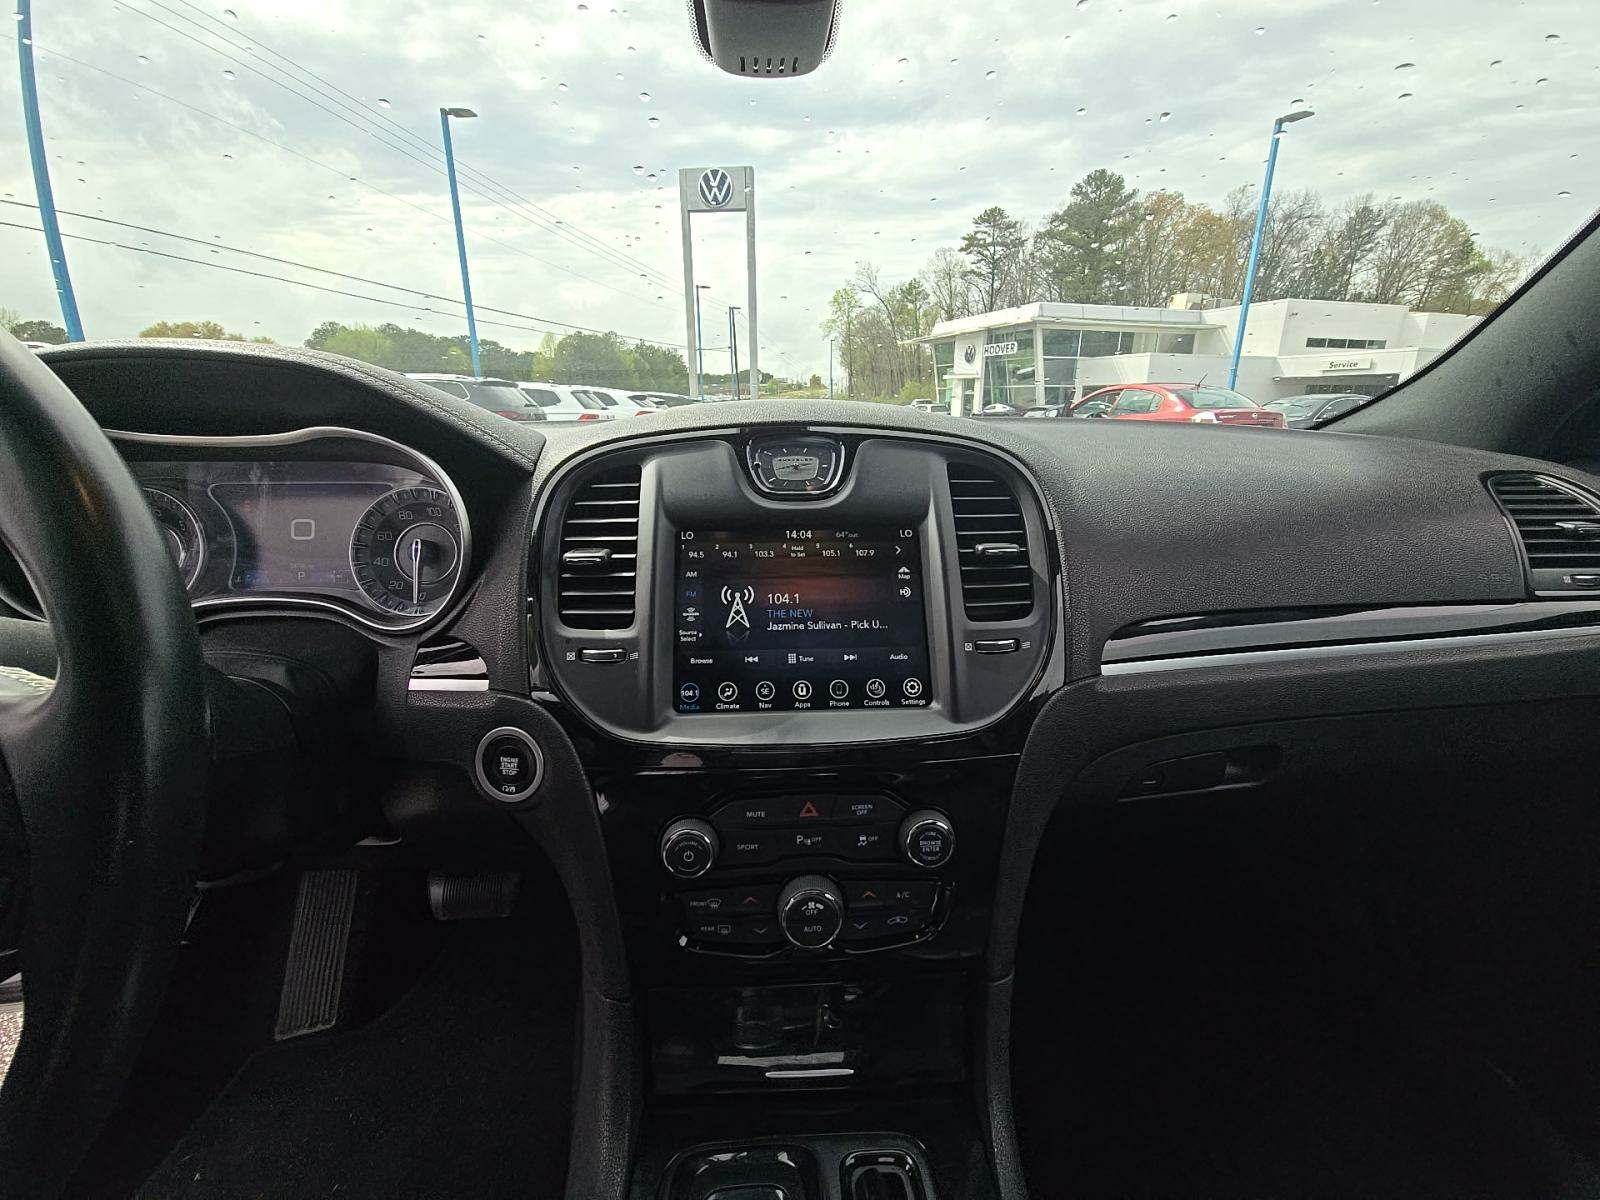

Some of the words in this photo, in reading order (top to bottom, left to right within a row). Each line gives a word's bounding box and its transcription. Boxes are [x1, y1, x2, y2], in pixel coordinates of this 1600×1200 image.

[984, 343, 1016, 355] HOOVER
[1328, 361, 1359, 369] Service
[399, 510, 413, 520] 80
[377, 531, 393, 541] 60
[681, 531, 694, 540] LO
[785, 530, 812, 539] 14:04
[900, 529, 913, 538] LO
[688, 551, 705, 559] 94.5
[754, 550, 775, 558] 103.3
[822, 549, 841, 557] 105.1
[855, 549, 875, 557] 107.9
[373, 557, 389, 567] 40
[389, 580, 404, 590] 20
[767, 593, 800, 604] 104.1
[767, 609, 788, 618] THE
[790, 608, 813, 618] NEW
[767, 621, 805, 631] Jazmine
[807, 620, 842, 630] Sullivan
[851, 620, 869, 629] Pick
[690, 657, 714, 665] Browse
[889, 653, 909, 661] Audio
[715, 702, 741, 710] Climate
[794, 701, 811, 709] Apps
[829, 700, 849, 708] Phone
[863, 699, 890, 707] Controls
[900, 698, 926, 706] Settings
